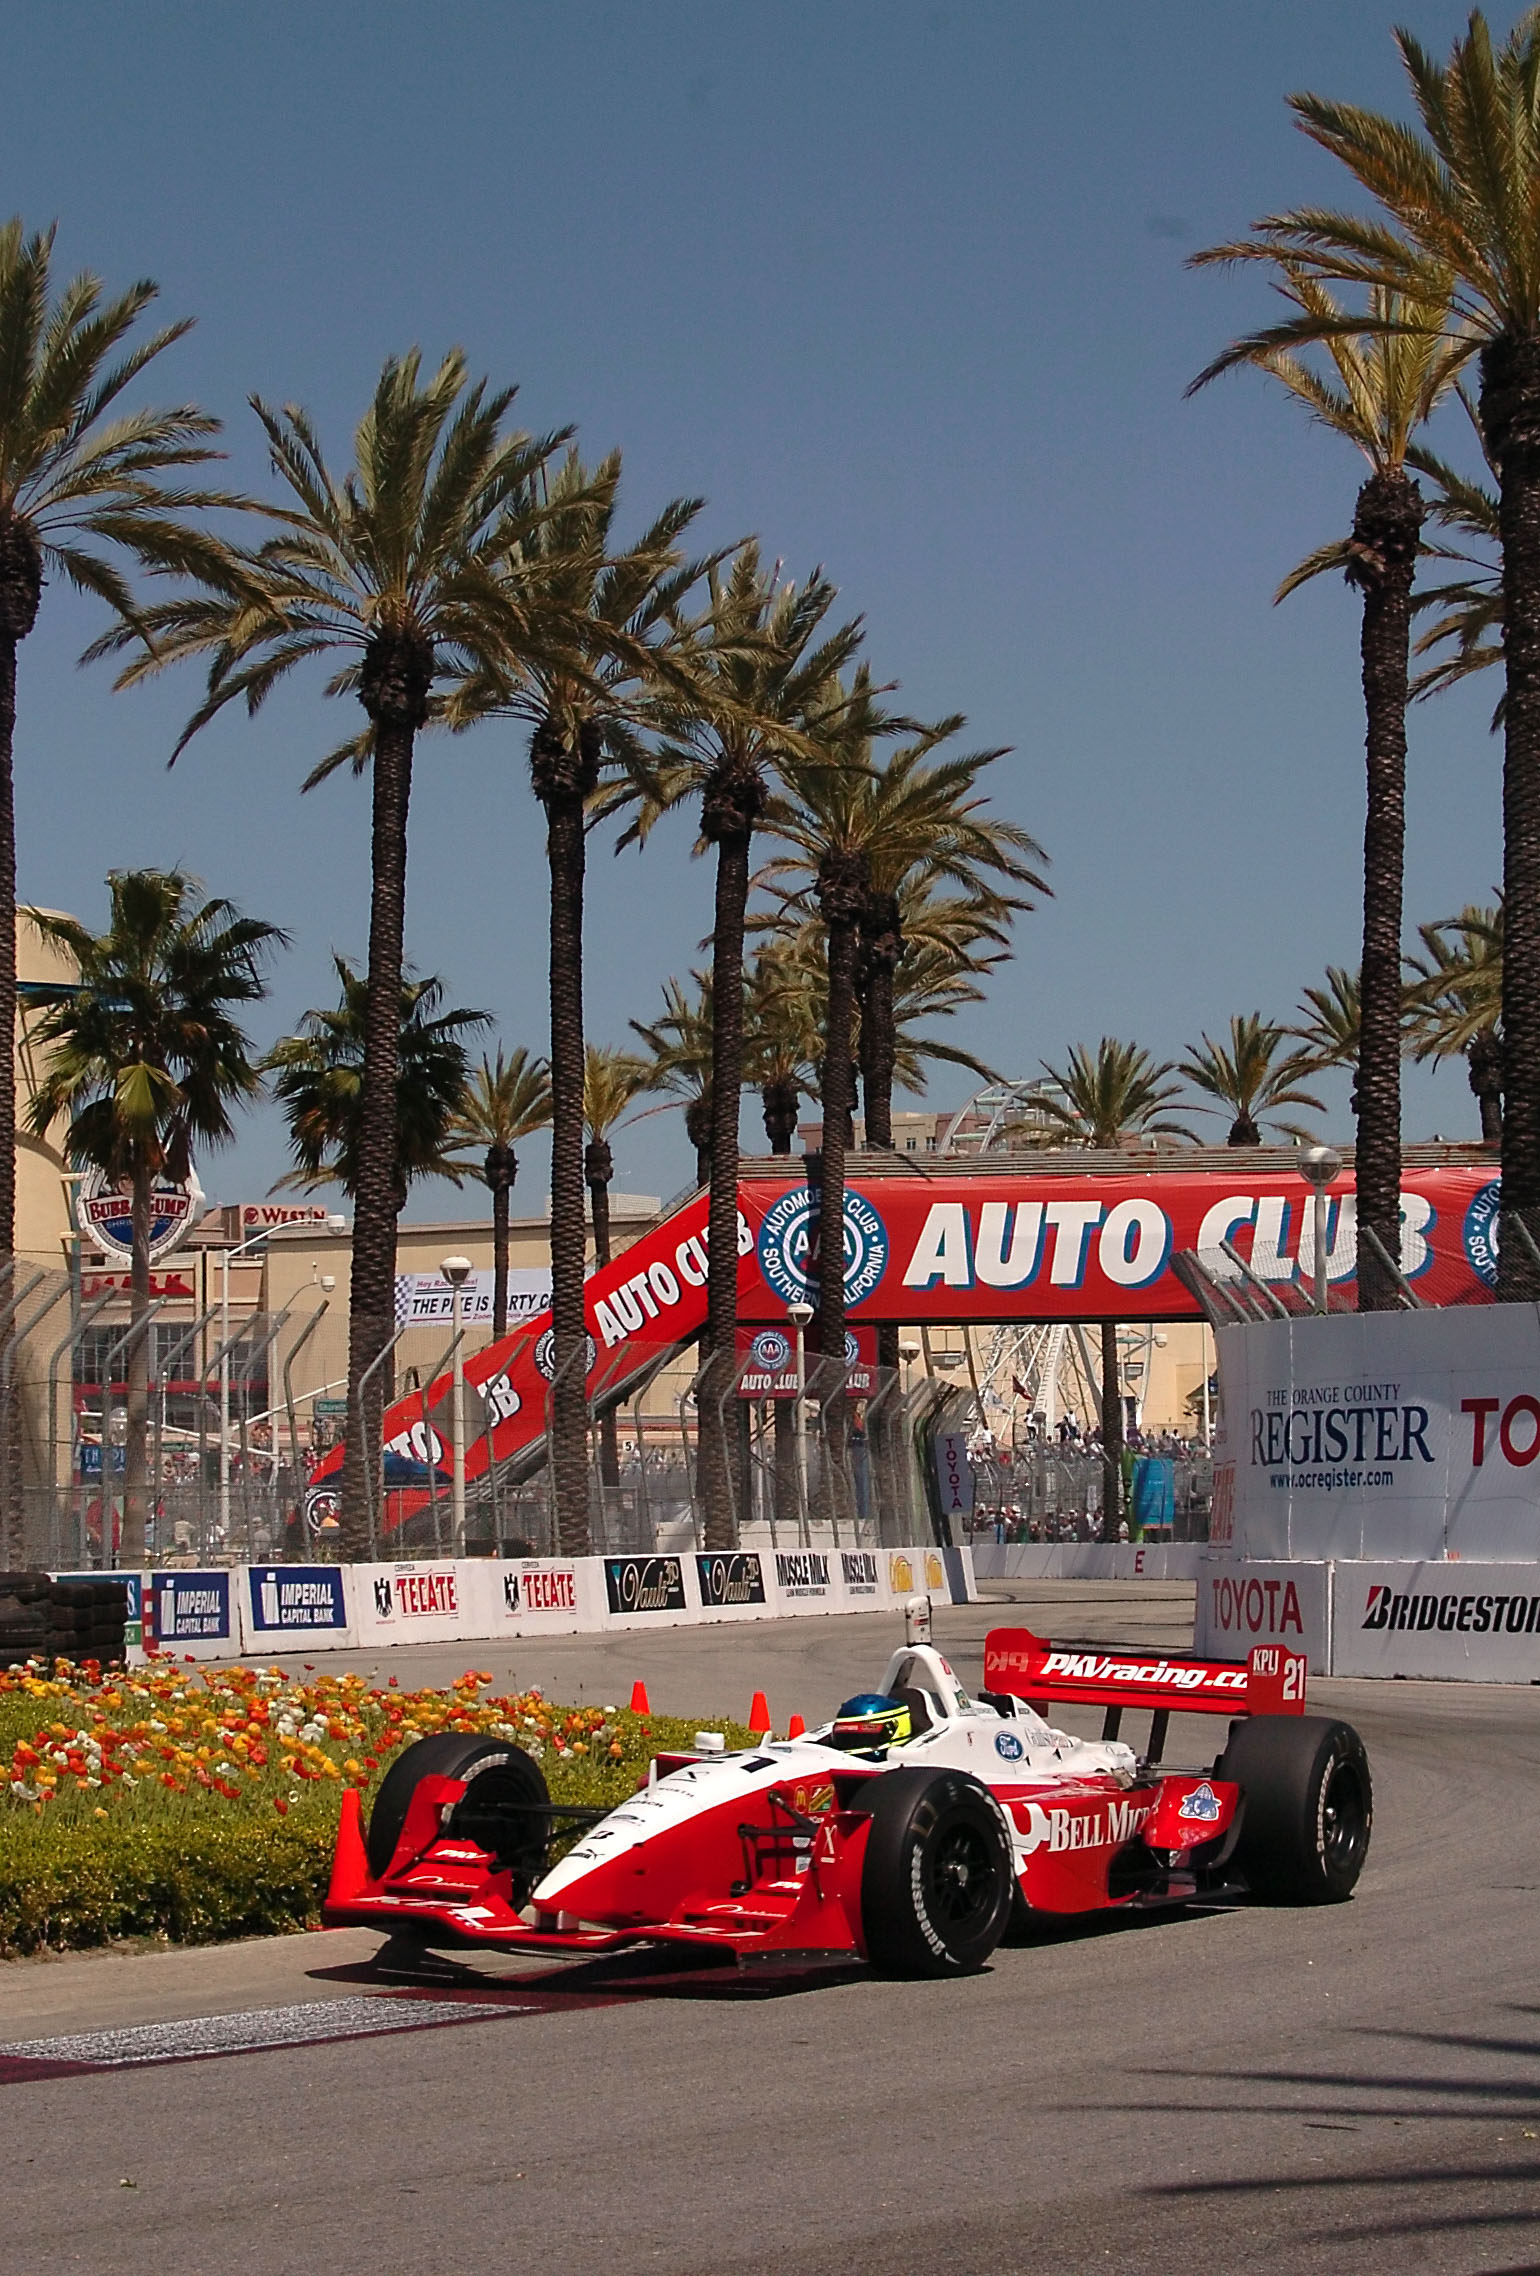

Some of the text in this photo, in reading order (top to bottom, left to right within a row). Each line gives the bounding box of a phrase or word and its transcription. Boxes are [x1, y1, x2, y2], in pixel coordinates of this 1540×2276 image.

[89, 1199, 131, 1220] BUBB
[847, 1199, 879, 1234] CLUB
[902, 1199, 1166, 1287] AUTO
[594, 1211, 754, 1348] AUTO CLB
[843, 1244, 885, 1304] ALIFORNIA
[412, 1298, 438, 1315] THE
[475, 1295, 490, 1312] IS
[740, 1374, 772, 1390] AUTO
[1267, 1384, 1401, 1406] THE ORANGE COUNTY
[622, 1441, 632, 1452] 5
[1251, 1405, 1435, 1466] REGISTER
[944, 1439, 962, 1509] TOYOTA
[1270, 1468, 1394, 1492] www.ocregister.com
[776, 1554, 809, 1586] MUSCLE
[1134, 1551, 1145, 1573] E
[280, 1583, 334, 1606] IMPERIAL
[622, 1559, 668, 1611] Vault
[176, 1590, 221, 1615] IMPERIAL
[280, 1607, 334, 1625] CAPITAL BANK
[1212, 1578, 1304, 1635] TOYOTA
[176, 1617, 220, 1634] CAPITAL BANK
[1282, 1658, 1305, 1700] 21
[1048, 1808, 1104, 1853] BELL
